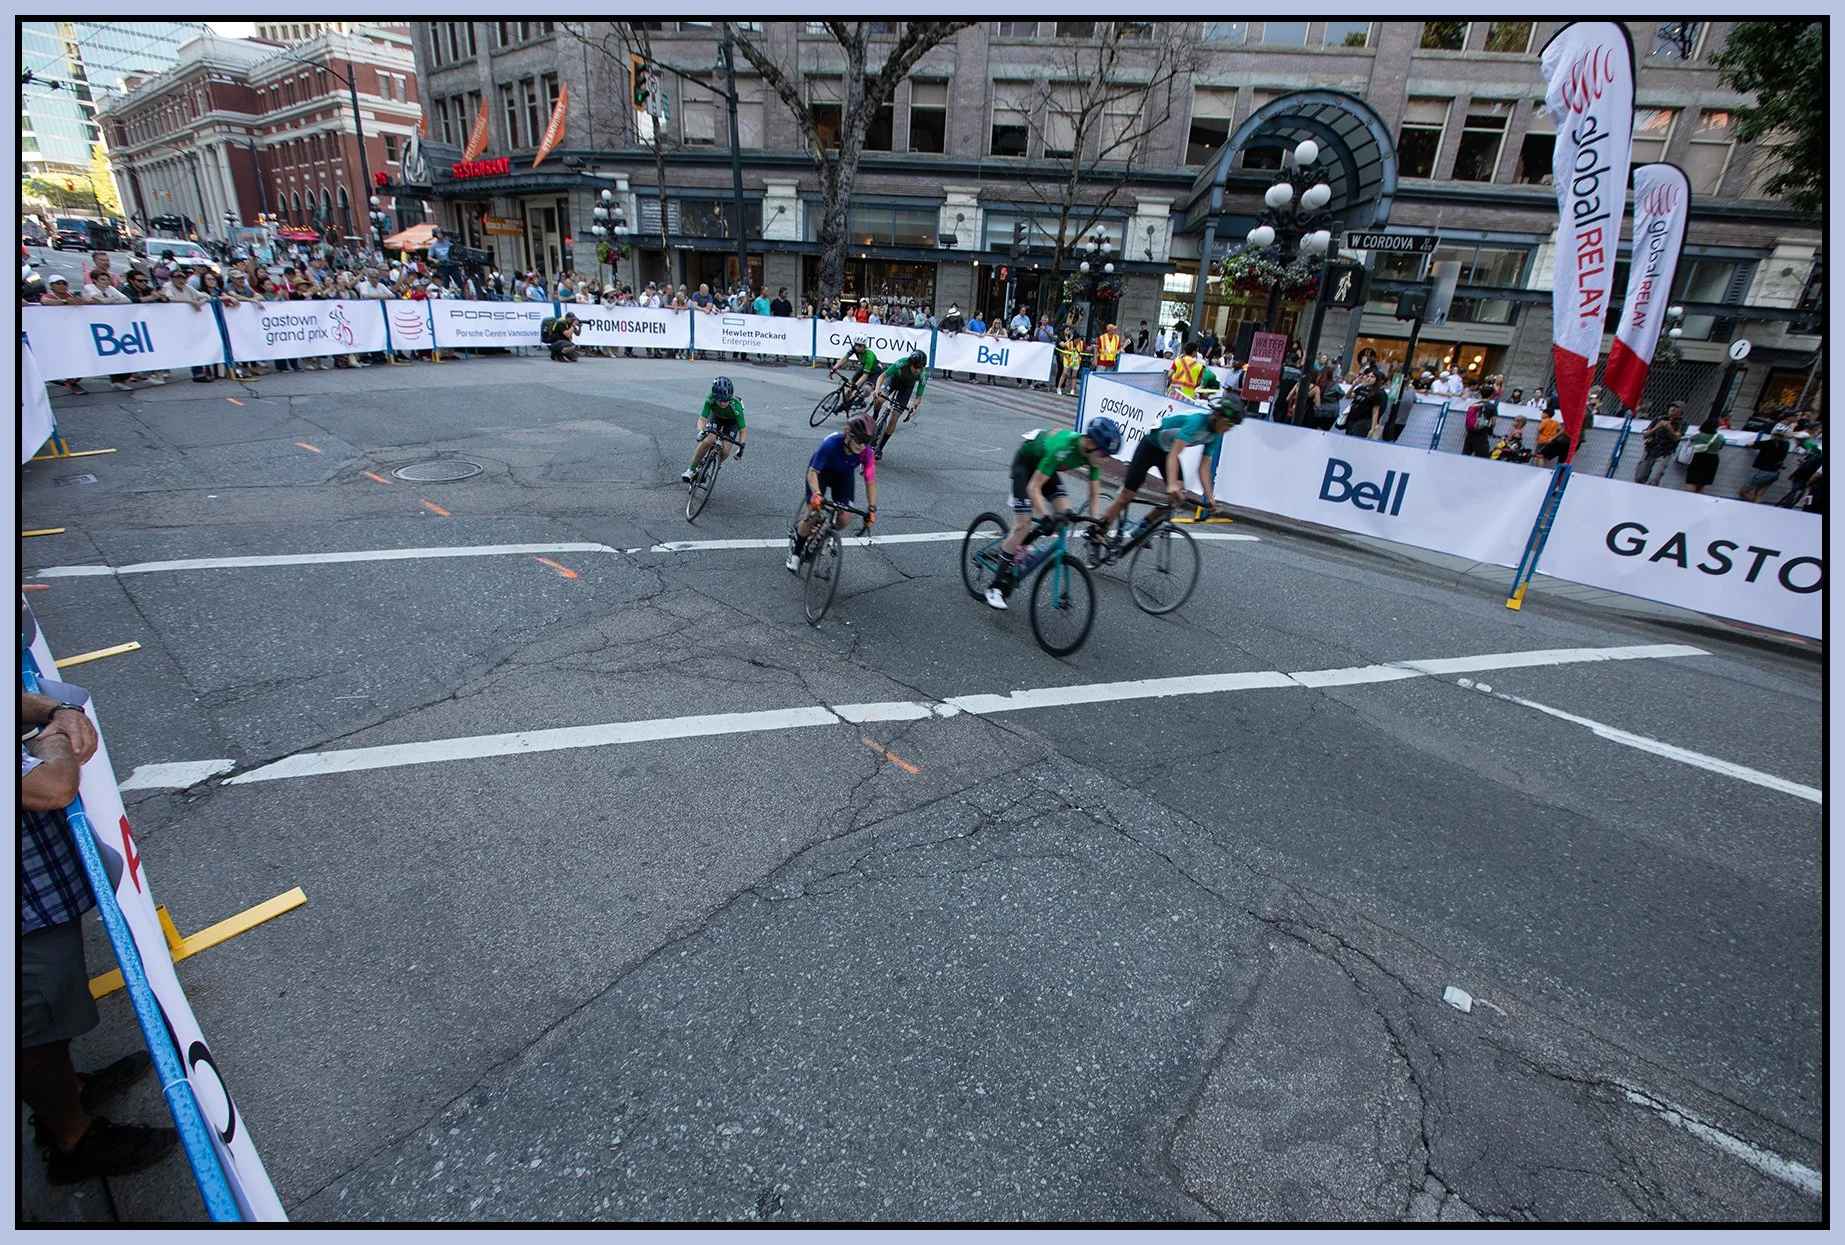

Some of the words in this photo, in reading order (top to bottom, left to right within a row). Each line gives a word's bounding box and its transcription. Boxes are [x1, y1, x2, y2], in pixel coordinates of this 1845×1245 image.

[1351, 234, 1361, 248] W
[1363, 235, 1414, 250] CORDOVA
[262, 314, 317, 331] gastown
[450, 310, 541, 320] PORSCHE
[456, 329, 484, 337] Porsche
[507, 329, 540, 337] Vancouver
[589, 319, 666, 334] PROMOSAPIEN
[722, 328, 753, 338] Hewlett
[754, 330, 787, 340] Packard
[90, 321, 154, 356] Bell
[266, 327, 305, 346] grand
[308, 327, 328, 343] prix
[722, 337, 761, 347] Enterprise
[829, 333, 917, 352] GATOWN
[1255, 337, 1285, 349] WATER
[977, 345, 1009, 366] Bell
[1252, 347, 1283, 360] STREET
[1100, 398, 1144, 422] gastown
[1126, 427, 1145, 442] pri
[1319, 457, 1410, 517] Bell
[1606, 521, 1822, 594] GASTO
